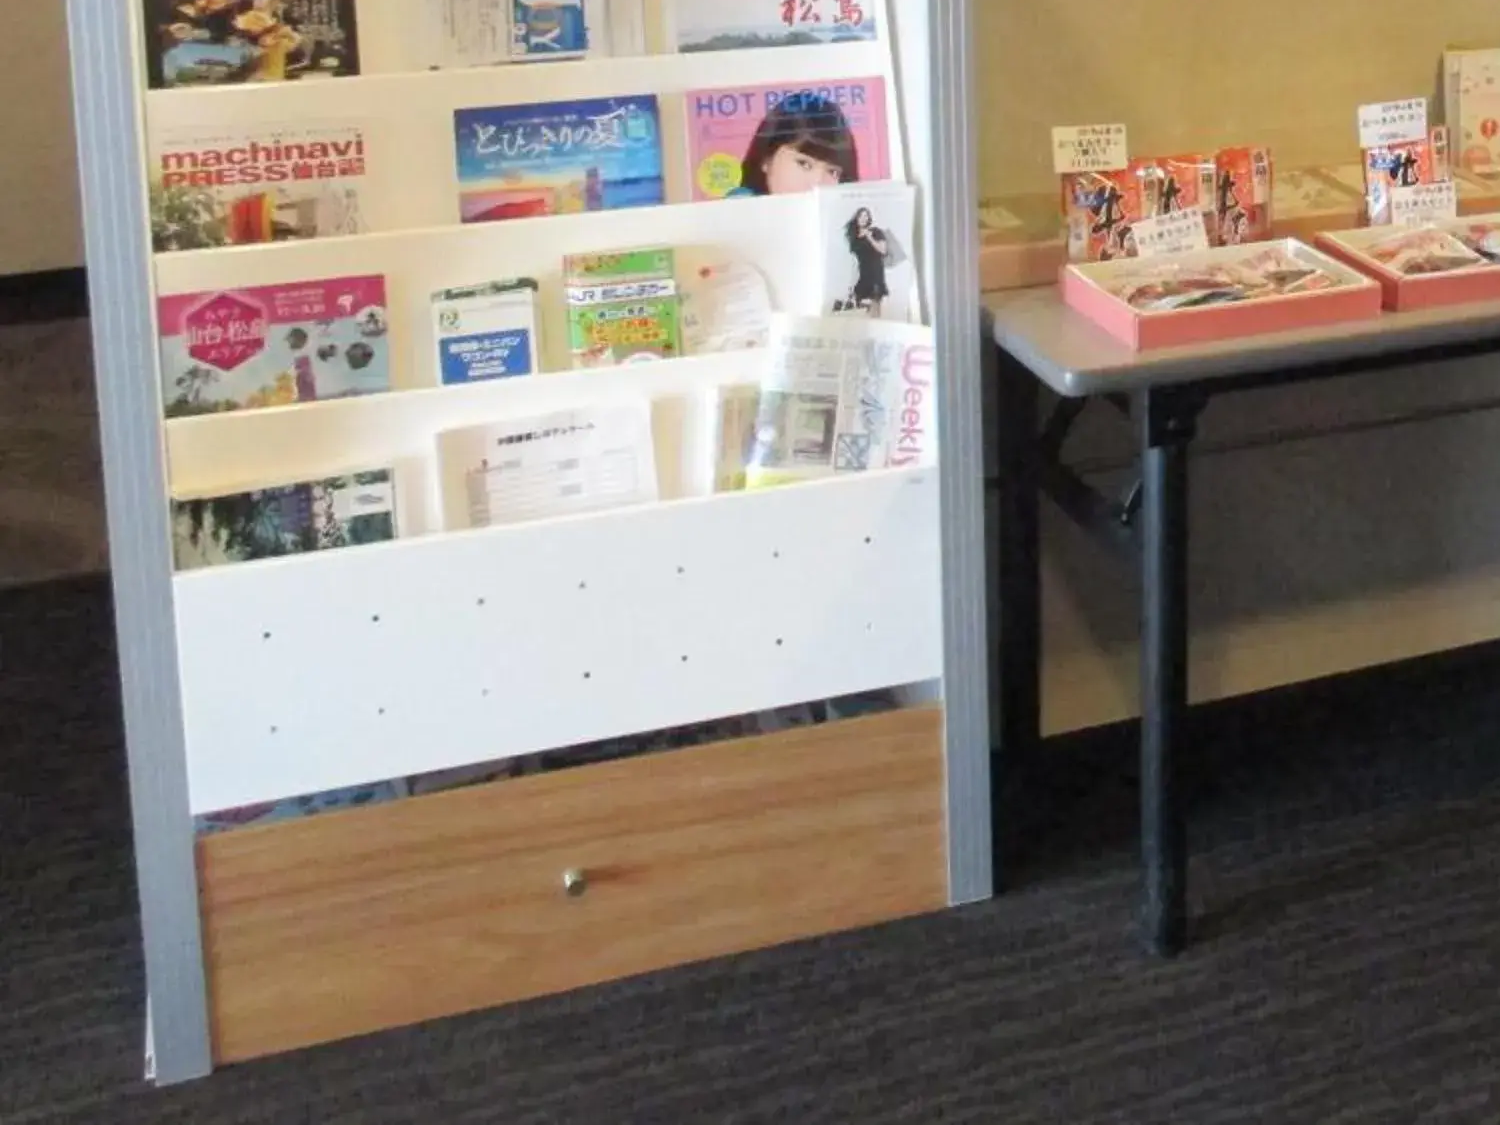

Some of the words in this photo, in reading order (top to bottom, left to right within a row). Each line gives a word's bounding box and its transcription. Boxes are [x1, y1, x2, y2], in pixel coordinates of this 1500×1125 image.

[695, 92, 757, 119] HOT
[764, 84, 867, 113] PEPPER
[161, 132, 365, 170] machinavi
